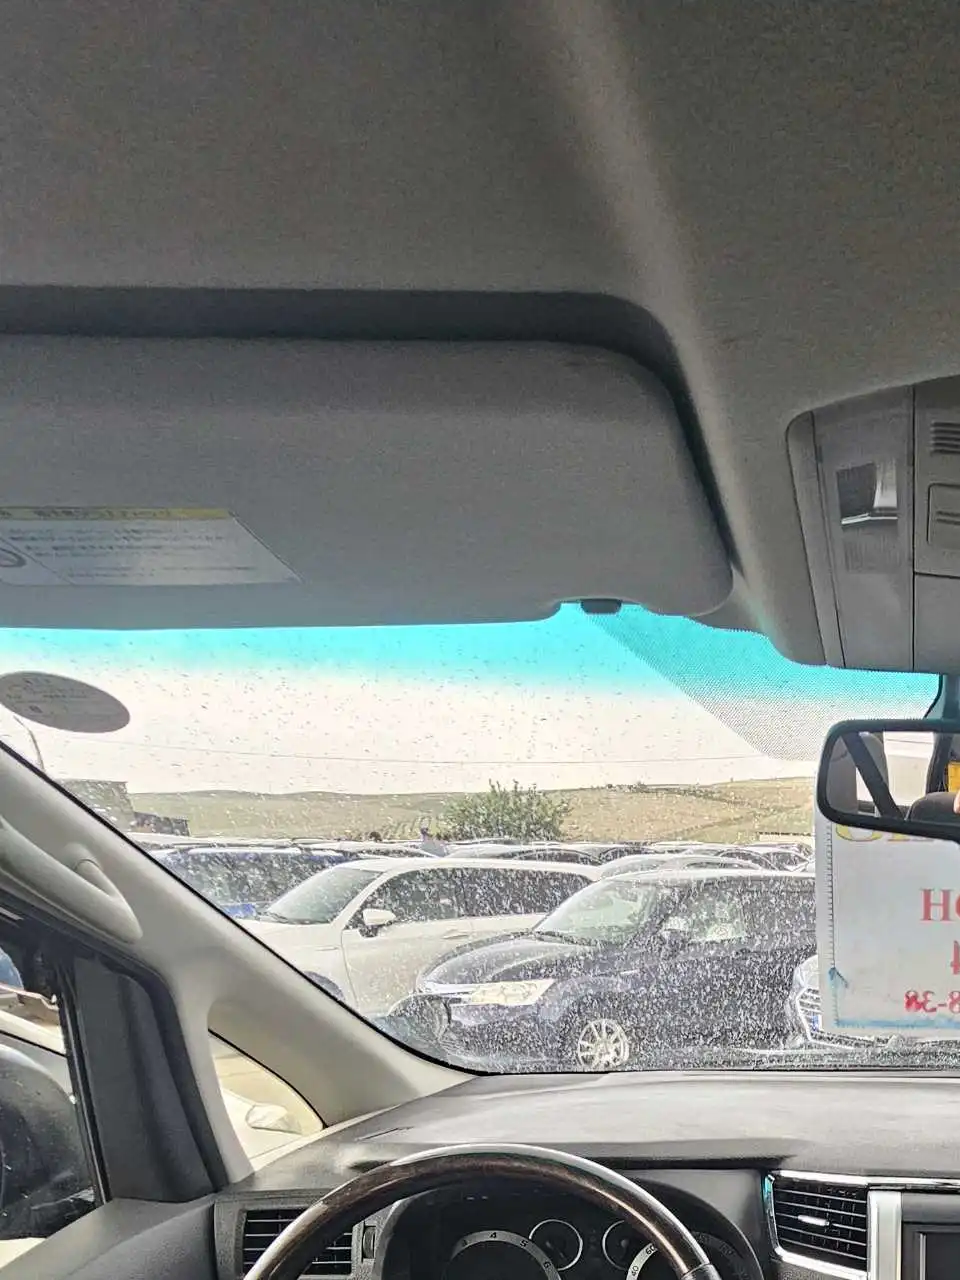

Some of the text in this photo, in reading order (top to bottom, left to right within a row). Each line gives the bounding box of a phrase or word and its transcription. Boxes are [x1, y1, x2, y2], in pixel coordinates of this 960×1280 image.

[490, 1231, 497, 1239] 4
[519, 1239, 528, 1248] 5
[543, 1260, 552, 1269] 6
[631, 1265, 639, 1276] 40
